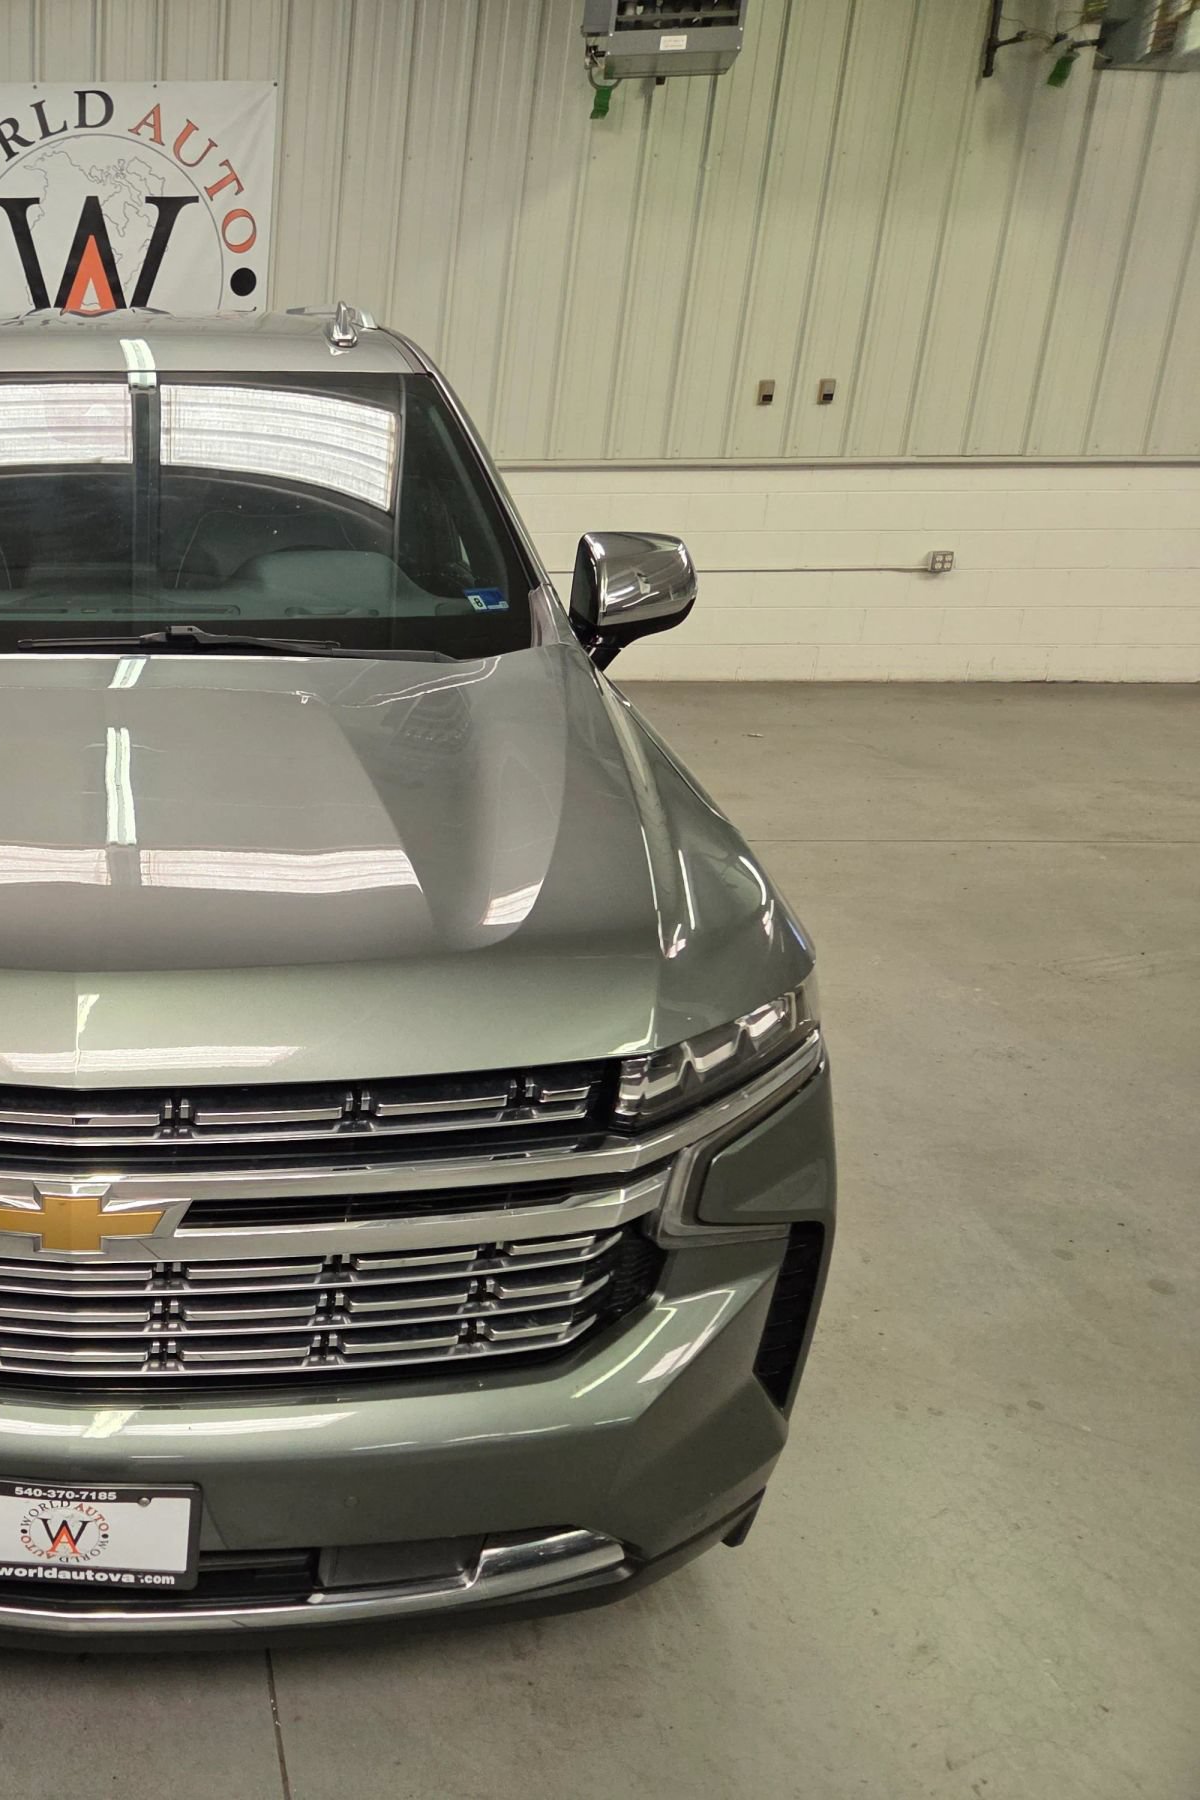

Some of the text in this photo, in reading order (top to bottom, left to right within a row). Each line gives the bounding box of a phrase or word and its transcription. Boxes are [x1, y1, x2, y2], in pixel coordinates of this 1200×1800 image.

[128, 103, 257, 254] AUTO
[14, 1486, 117, 1501] 540-370-7185
[20, 1500, 109, 1532] WORLD AUTO
